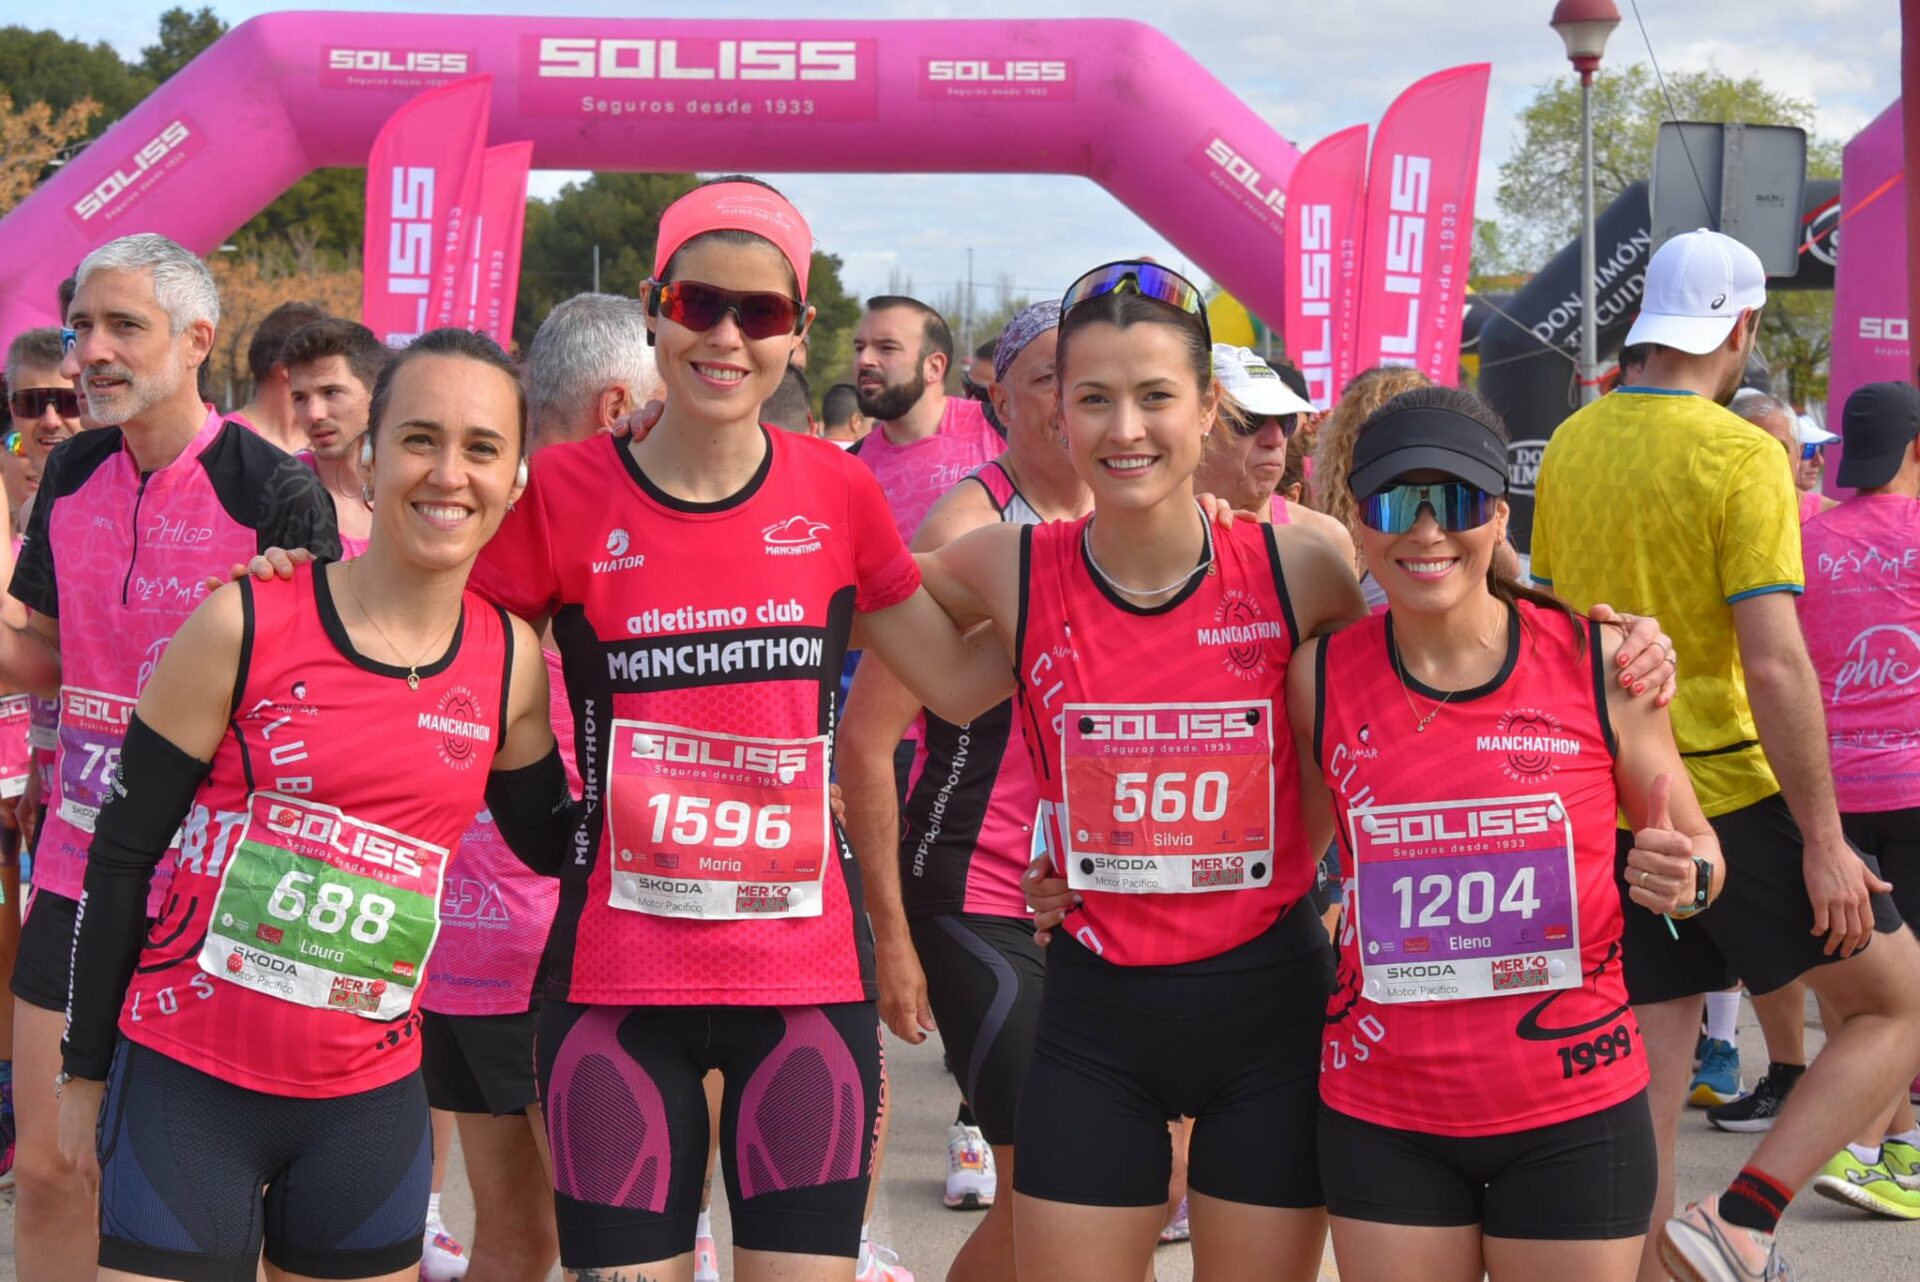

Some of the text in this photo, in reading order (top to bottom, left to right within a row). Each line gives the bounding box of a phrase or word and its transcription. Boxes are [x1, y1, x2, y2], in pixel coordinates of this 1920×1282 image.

[329, 49, 468, 74] SOLISS
[539, 38, 856, 81] SOLISS
[928, 61, 1066, 81] SOLISS
[581, 95, 815, 116] Seguros desde 1933
[73, 120, 191, 220] SOLISS
[1439, 203, 1457, 252] 1933
[1532, 227, 1652, 344] DON IMÓN
[765, 541, 822, 556] MANCHATHON
[592, 554, 645, 574] VIATOR
[626, 598, 805, 636] atletismo club
[607, 636, 824, 683] MANCHATHON
[417, 712, 491, 742] MANCHATHON
[1081, 712, 1254, 741] SOLISS
[631, 732, 808, 774] SOLISS
[1103, 742, 1232, 754] Seguros desde 1933
[1476, 735, 1580, 756] MANCHATHON
[654, 763, 784, 786] Seguros desde 193
[1112, 771, 1229, 823] 560
[648, 793, 792, 850] 1596
[1370, 806, 1549, 845] SOLISS
[267, 804, 426, 878] SOLISS
[286, 838, 332, 860] Seguros
[1153, 832, 1194, 847] Silvia
[1393, 838, 1526, 858] Seguros desde 1933
[699, 857, 742, 872] Maria
[1095, 876, 1120, 888] Motor
[1192, 869, 1244, 888] CASH
[267, 870, 396, 945] 688
[638, 897, 664, 908] Motor
[736, 896, 790, 913] CASH
[1392, 866, 1541, 929] 1204
[300, 938, 345, 964] Laura
[1449, 935, 1492, 951] Elena
[1491, 956, 1547, 973] MERKO
[1387, 985, 1418, 997] Motor
[1493, 968, 1550, 991] CASH
[1557, 1024, 1632, 1079] 1999
